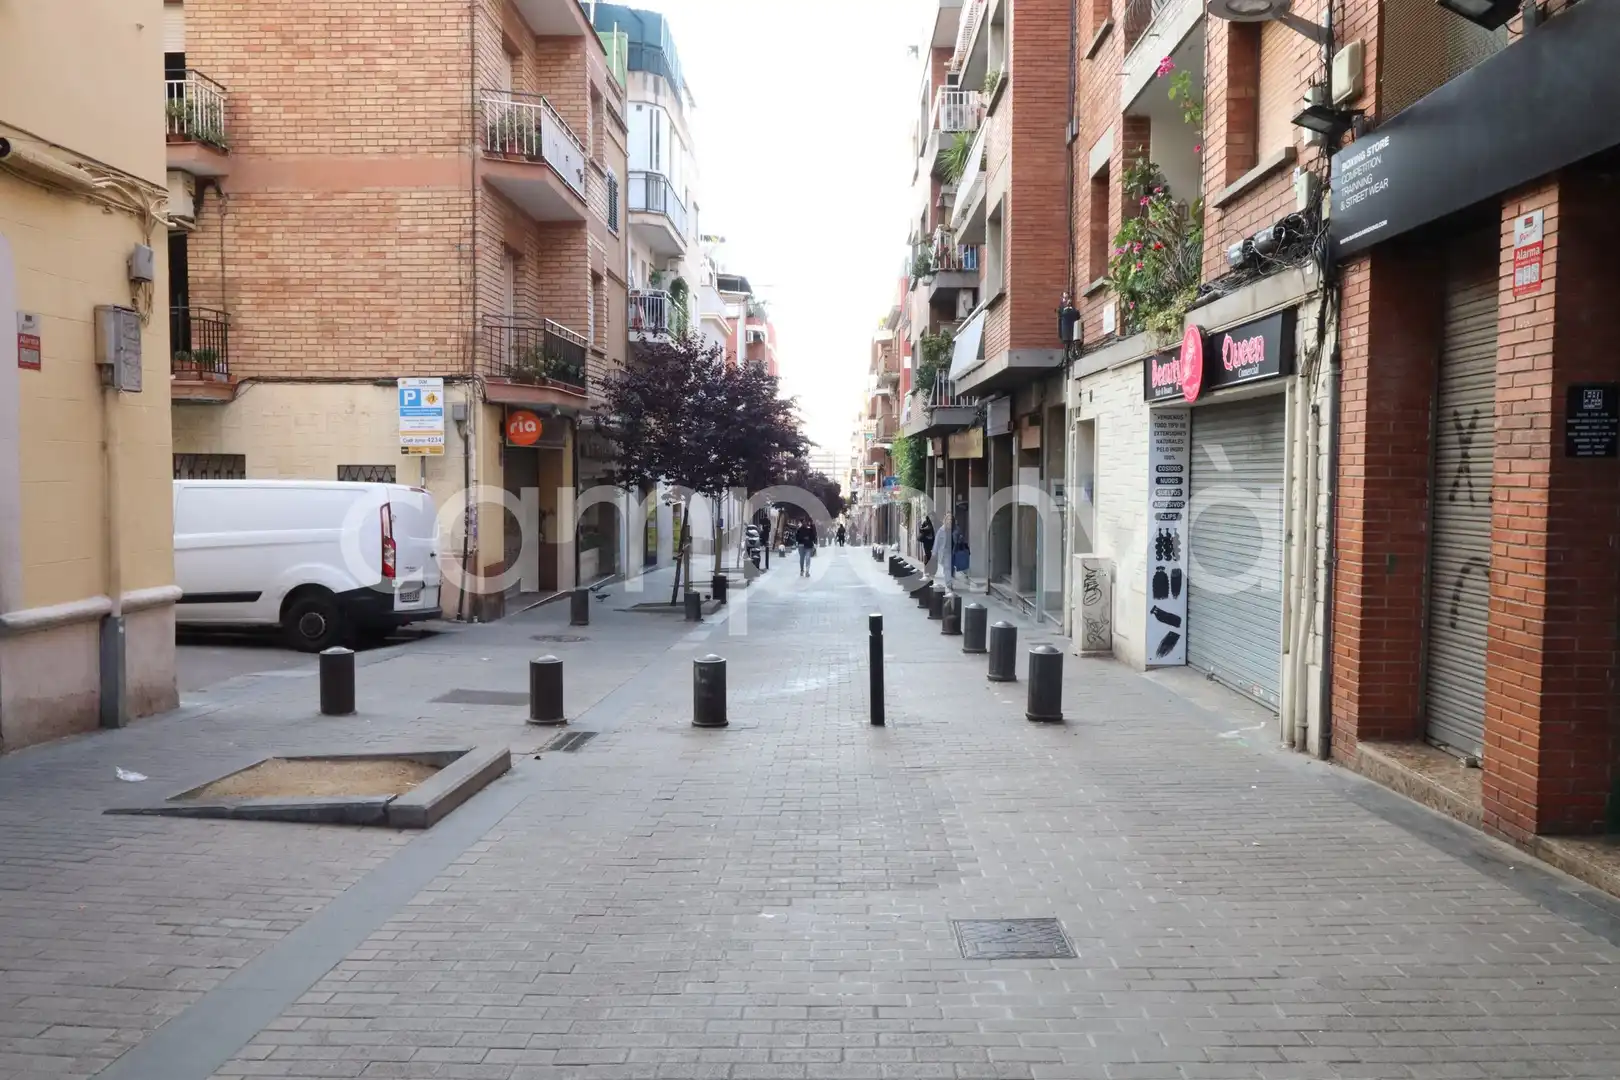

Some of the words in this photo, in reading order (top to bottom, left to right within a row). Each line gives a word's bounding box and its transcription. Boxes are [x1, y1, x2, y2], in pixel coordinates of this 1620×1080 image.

[1341, 150, 1366, 173] BOXING
[1366, 135, 1390, 157] STORE
[1340, 200, 1346, 211] &
[1345, 187, 1369, 209] STREET
[1368, 177, 1389, 196] WEAR
[1516, 246, 1541, 262] Alarma
[1221, 332, 1265, 372] Queen
[403, 390, 417, 406] P
[509, 415, 537, 434] ria
